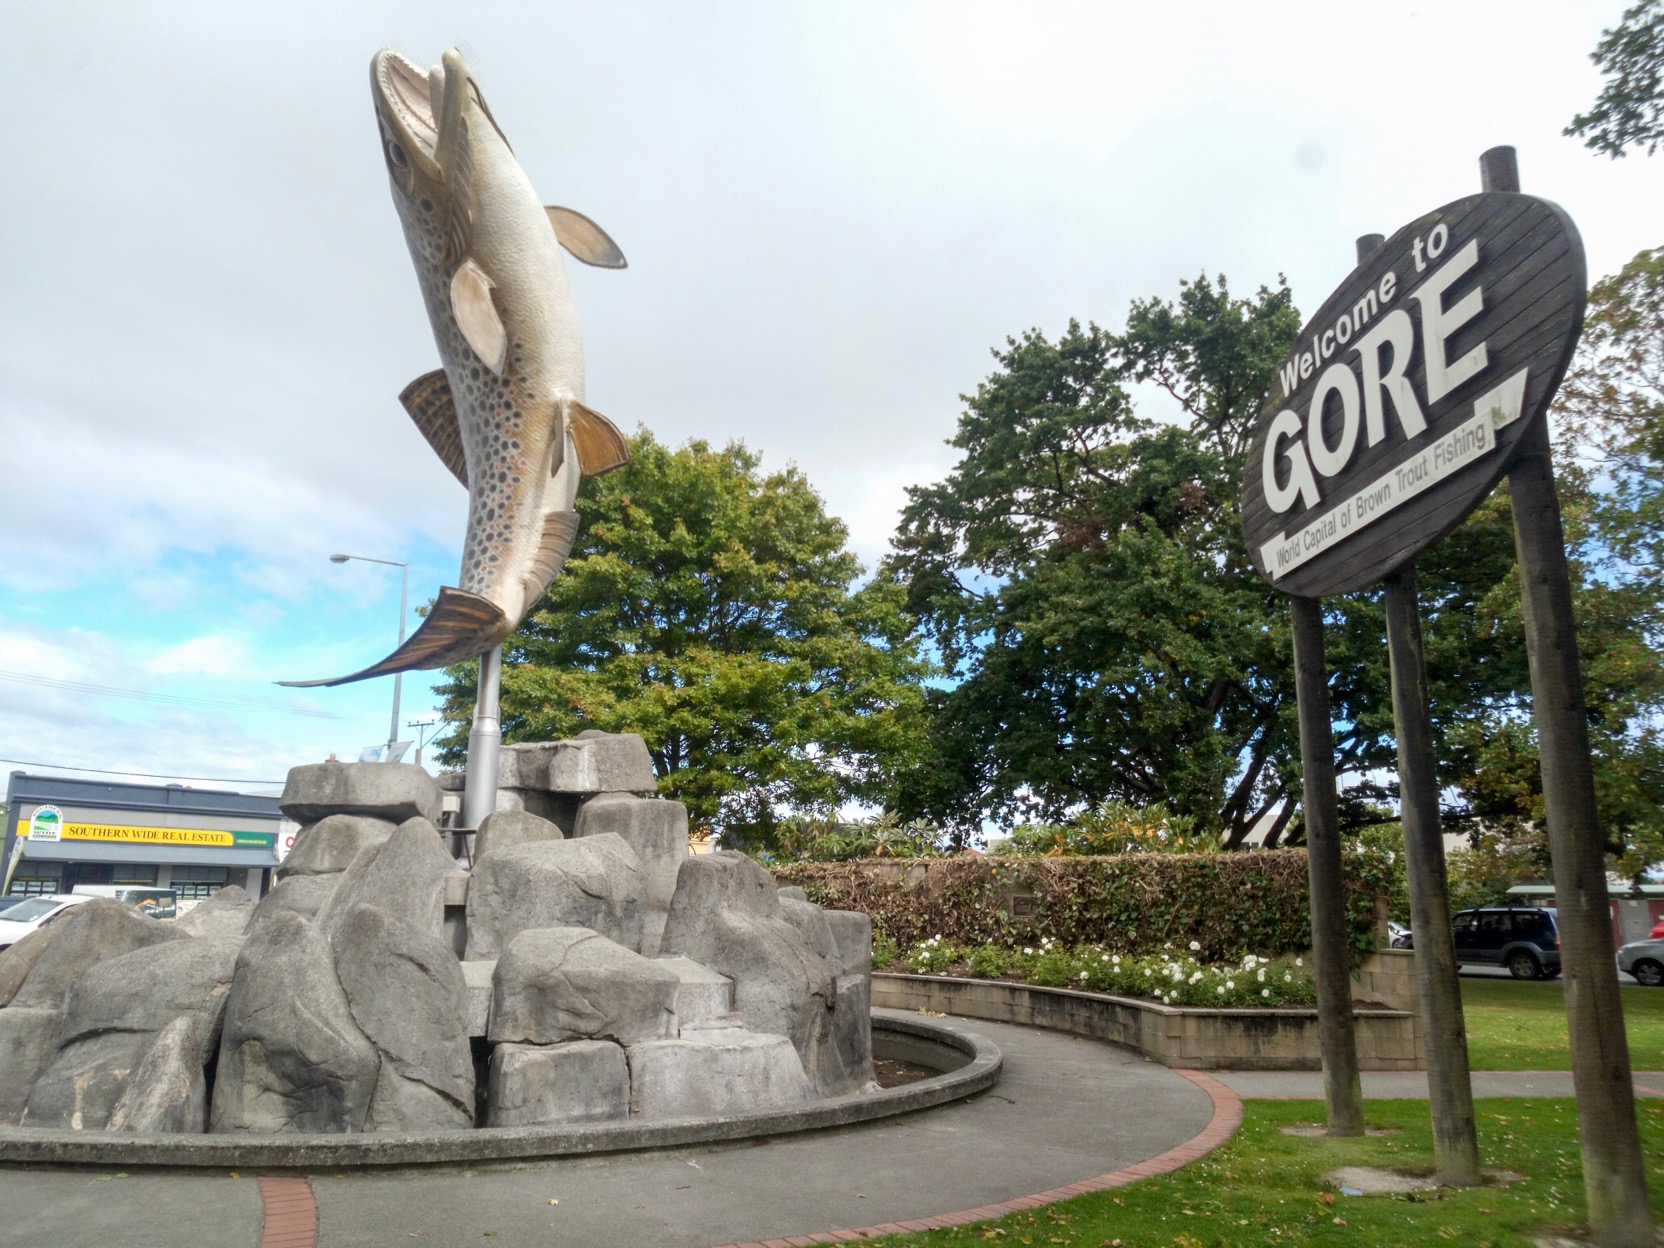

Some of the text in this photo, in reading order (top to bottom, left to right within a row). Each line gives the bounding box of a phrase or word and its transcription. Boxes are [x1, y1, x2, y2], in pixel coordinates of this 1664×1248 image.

[1262, 238, 1489, 514] GORE
[1279, 223, 1449, 398] Welcome to
[1276, 422, 1486, 568] World Capital of Brown Trout Fishing
[69, 826, 129, 838] SOUTHERN
[132, 829, 160, 840] WIDE
[162, 831, 189, 841] REAL
[192, 833, 226, 843] ESTATE
